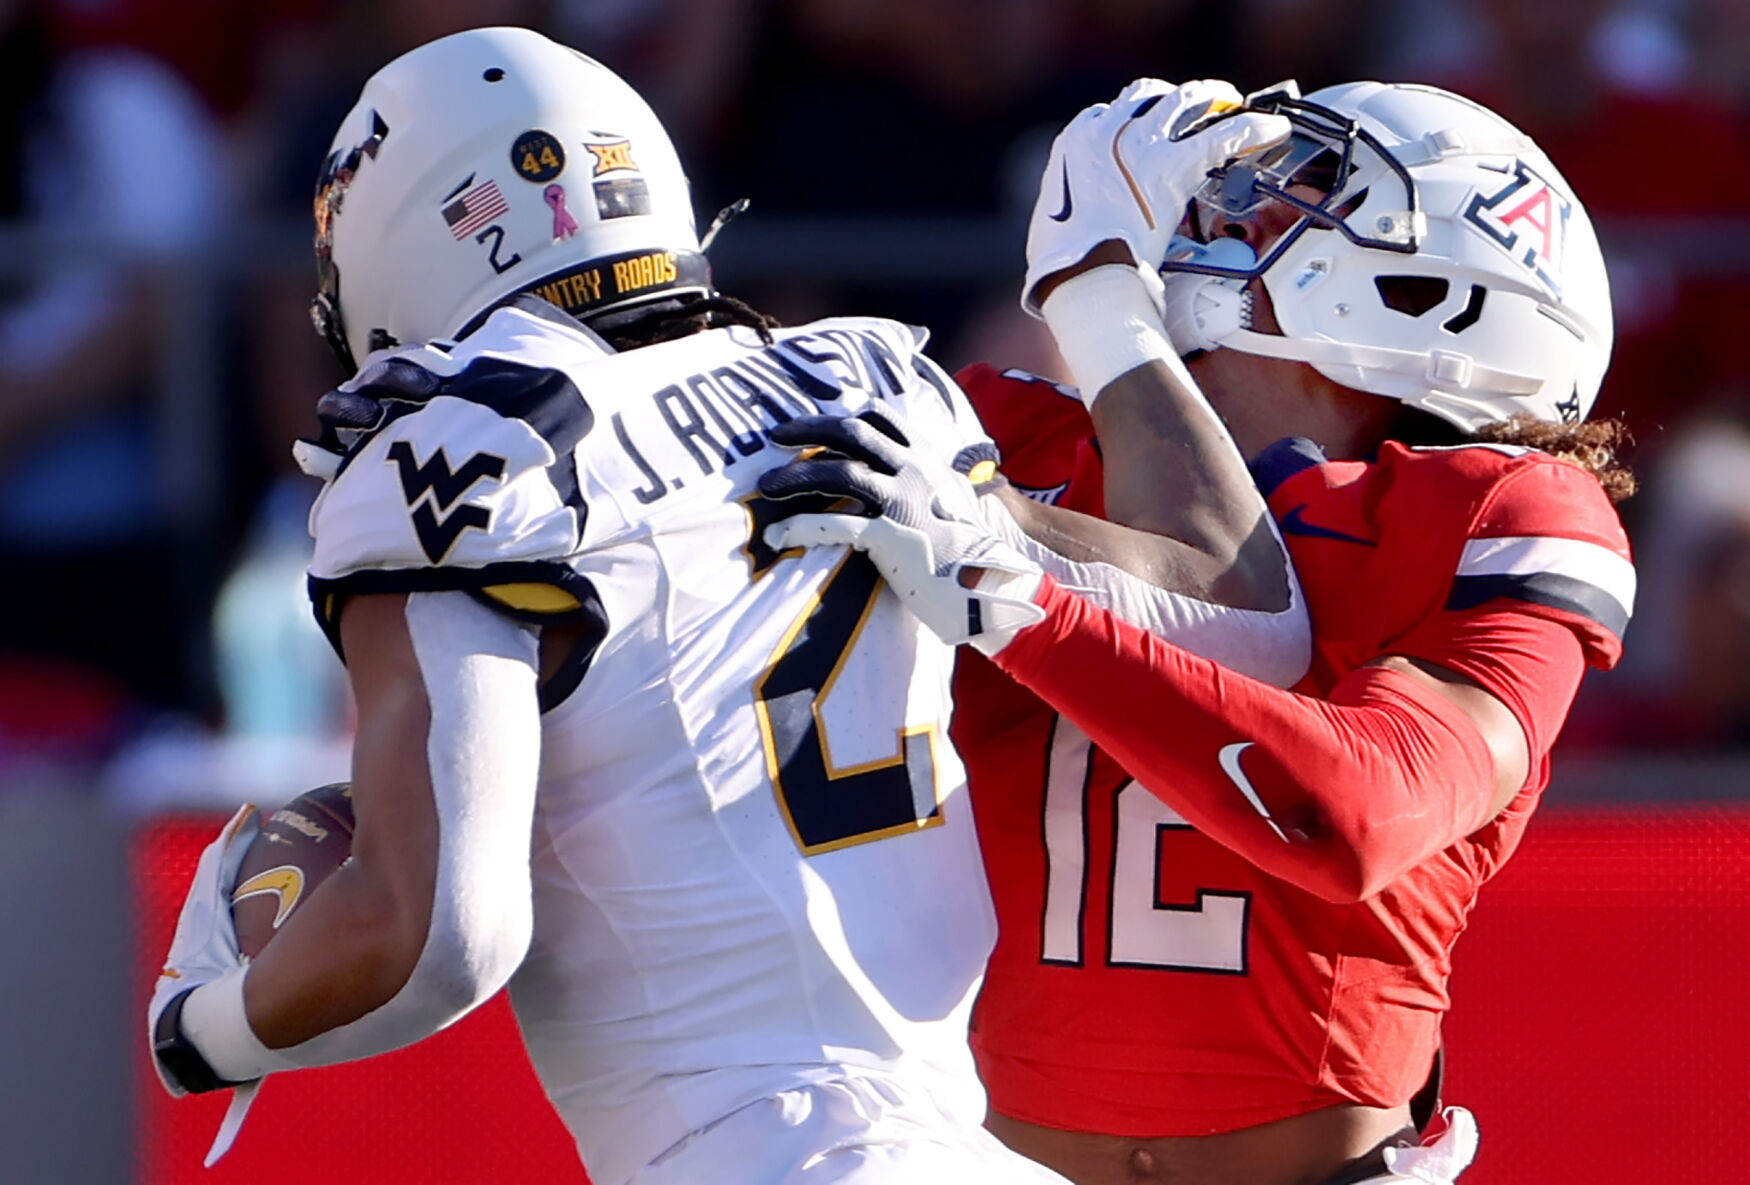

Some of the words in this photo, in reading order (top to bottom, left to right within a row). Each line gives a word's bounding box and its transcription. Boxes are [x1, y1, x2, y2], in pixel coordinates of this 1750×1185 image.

[522, 146, 559, 174] 44
[583, 139, 640, 178] XII
[476, 224, 520, 275] 2
[612, 252, 678, 293] ROADS
[1463, 158, 1572, 303] A
[611, 410, 685, 505] J.
[652, 329, 906, 477] ROBINSON
[736, 447, 945, 856] 2
[1040, 711, 1252, 975] 12
